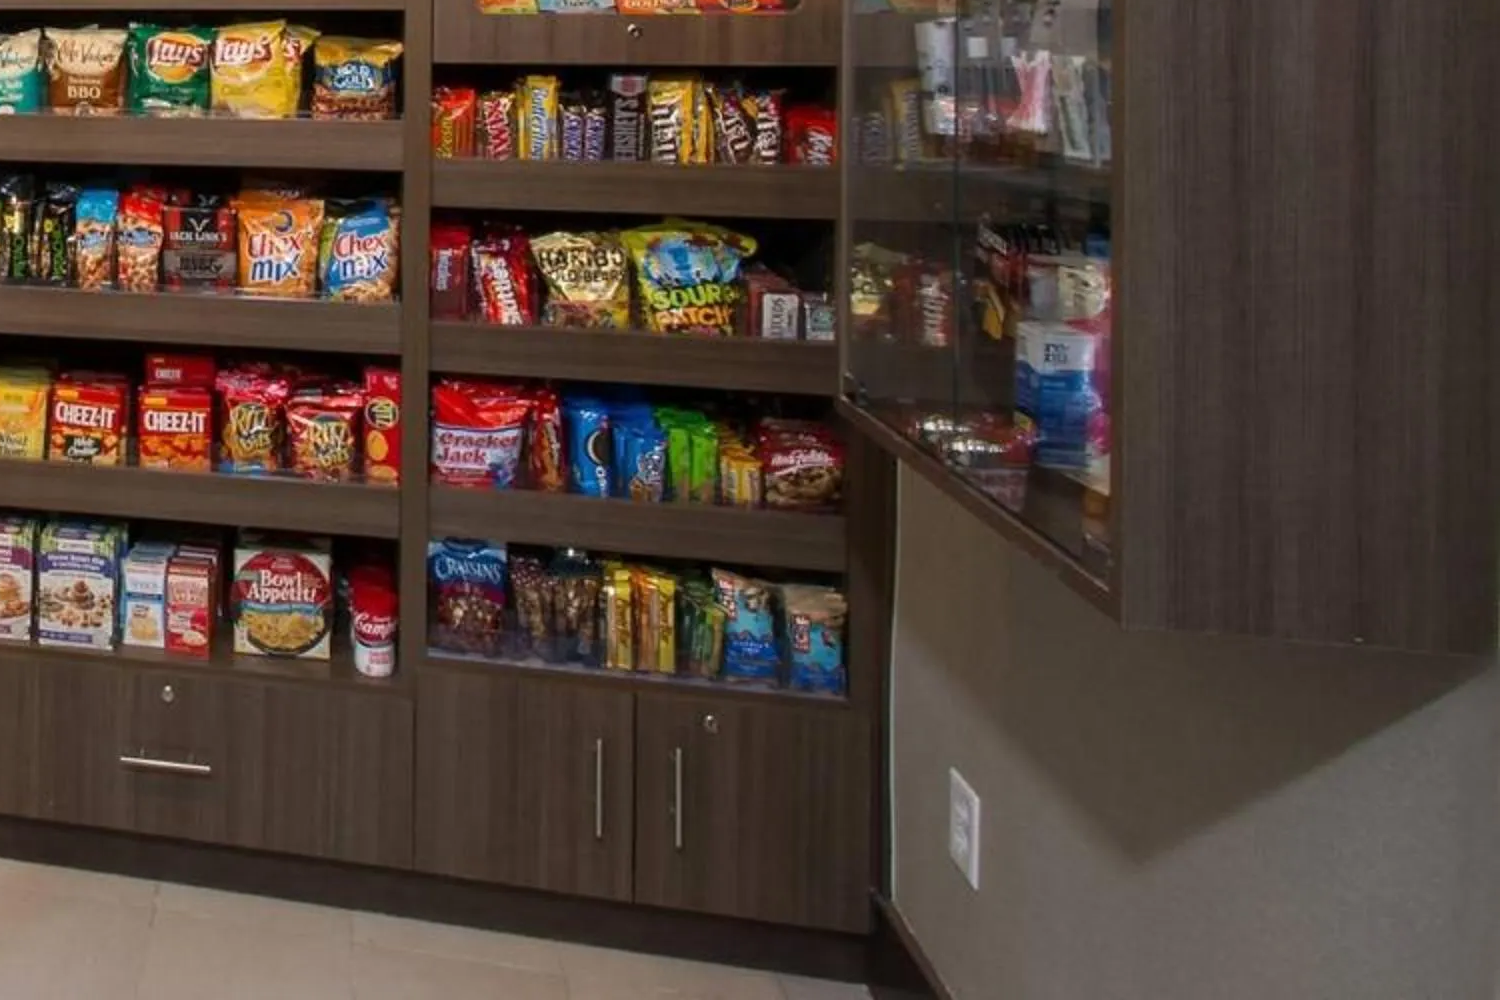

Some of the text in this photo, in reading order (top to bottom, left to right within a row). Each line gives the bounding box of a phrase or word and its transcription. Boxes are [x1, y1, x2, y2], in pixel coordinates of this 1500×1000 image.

[215, 36, 272, 66] Lay's
[67, 86, 101, 99] BBQ
[333, 74, 374, 90] GOLD
[614, 98, 638, 163] ERSHEY'S
[248, 231, 304, 258] Chex
[335, 232, 387, 258] Chex
[538, 249, 626, 269] HARIBO
[654, 284, 723, 311] SOUR
[656, 306, 732, 330] PATCH
[54, 401, 116, 428] CHEEZ-IT
[144, 409, 207, 432] CHEEZ-IT
[437, 448, 487, 464] Jack
[260, 569, 302, 587] Bowl
